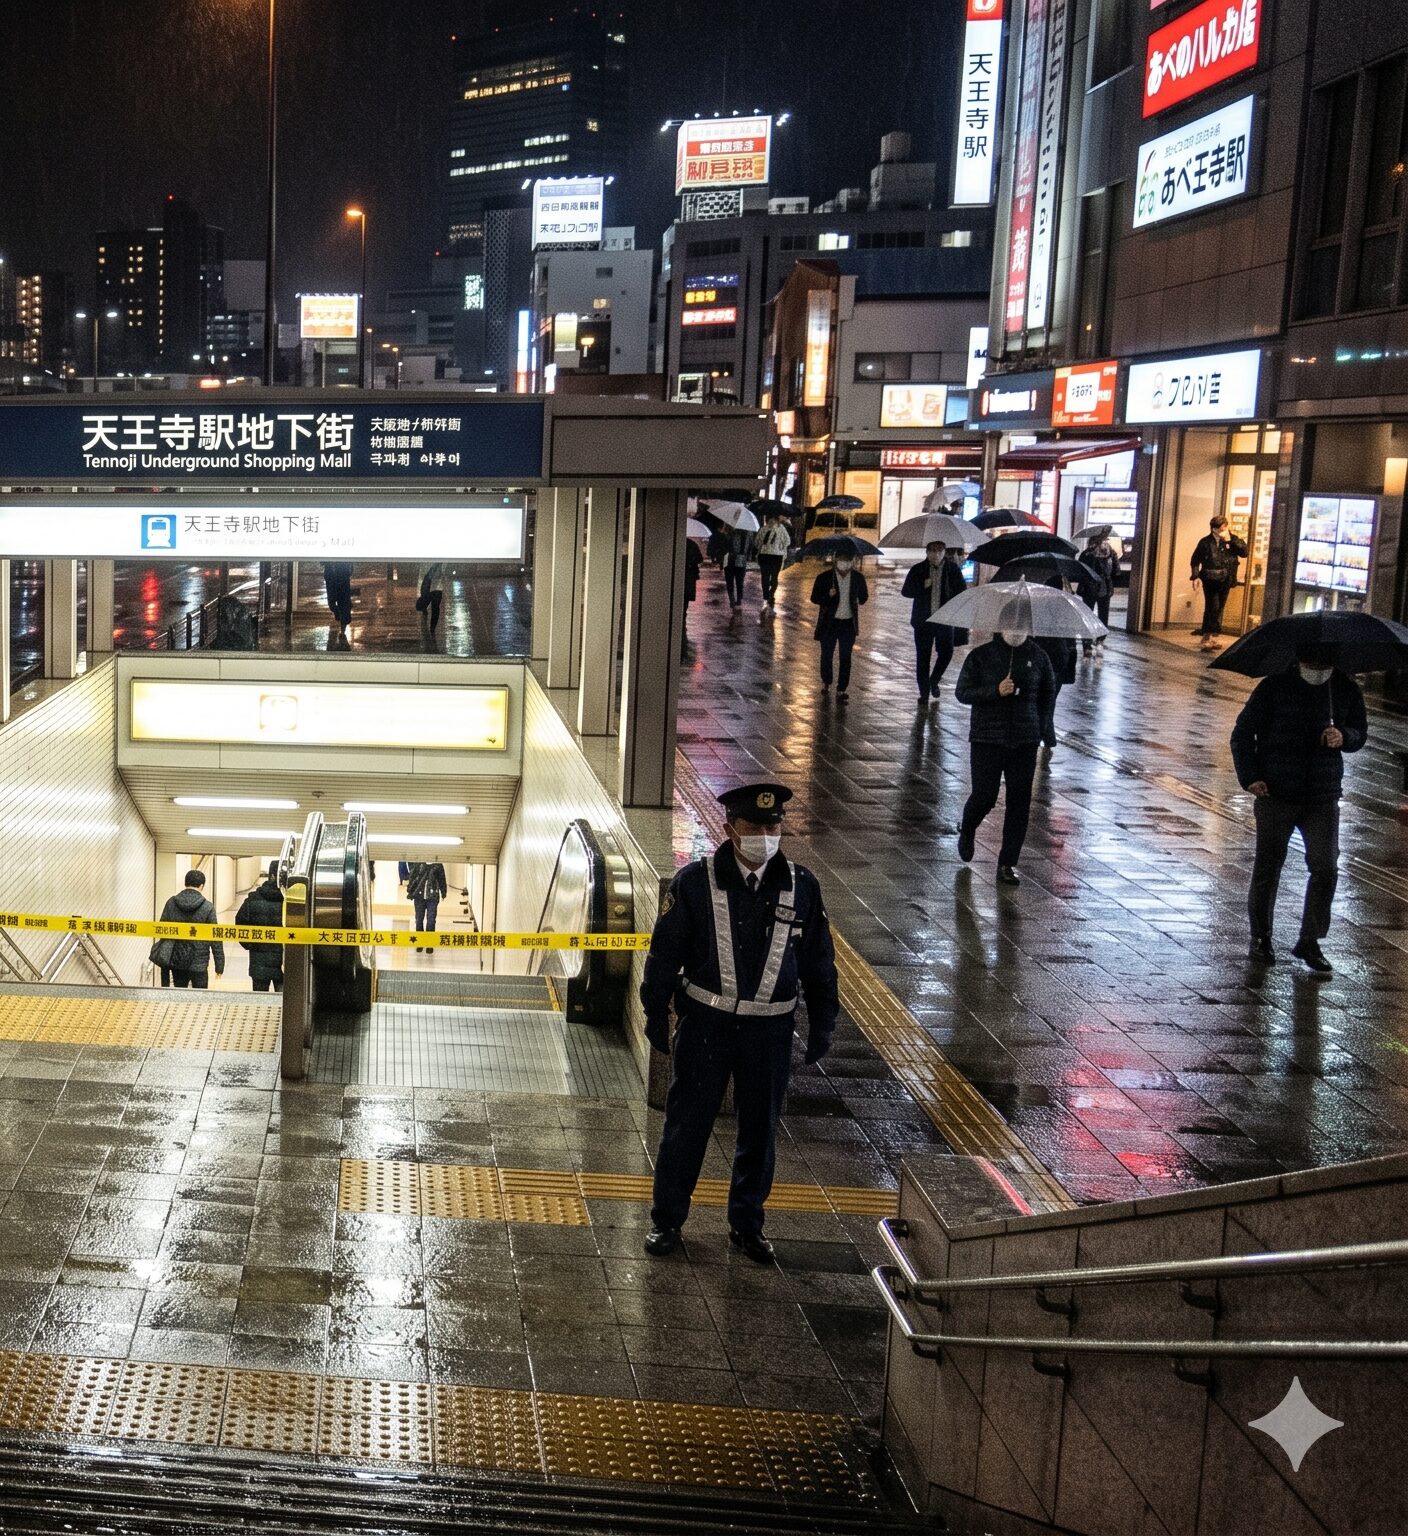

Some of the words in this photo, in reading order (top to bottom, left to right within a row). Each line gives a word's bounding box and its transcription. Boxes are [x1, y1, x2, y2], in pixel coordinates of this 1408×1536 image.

[963, 53, 993, 159] 天王寺駅
[81, 412, 354, 451] 天王寺駅地下街
[83, 453, 137, 472] Tennoji
[141, 453, 240, 472] Underground
[243, 453, 316, 472] Shopping
[320, 453, 352, 468] Mall
[184, 515, 320, 533] 天王寺駅地下街
